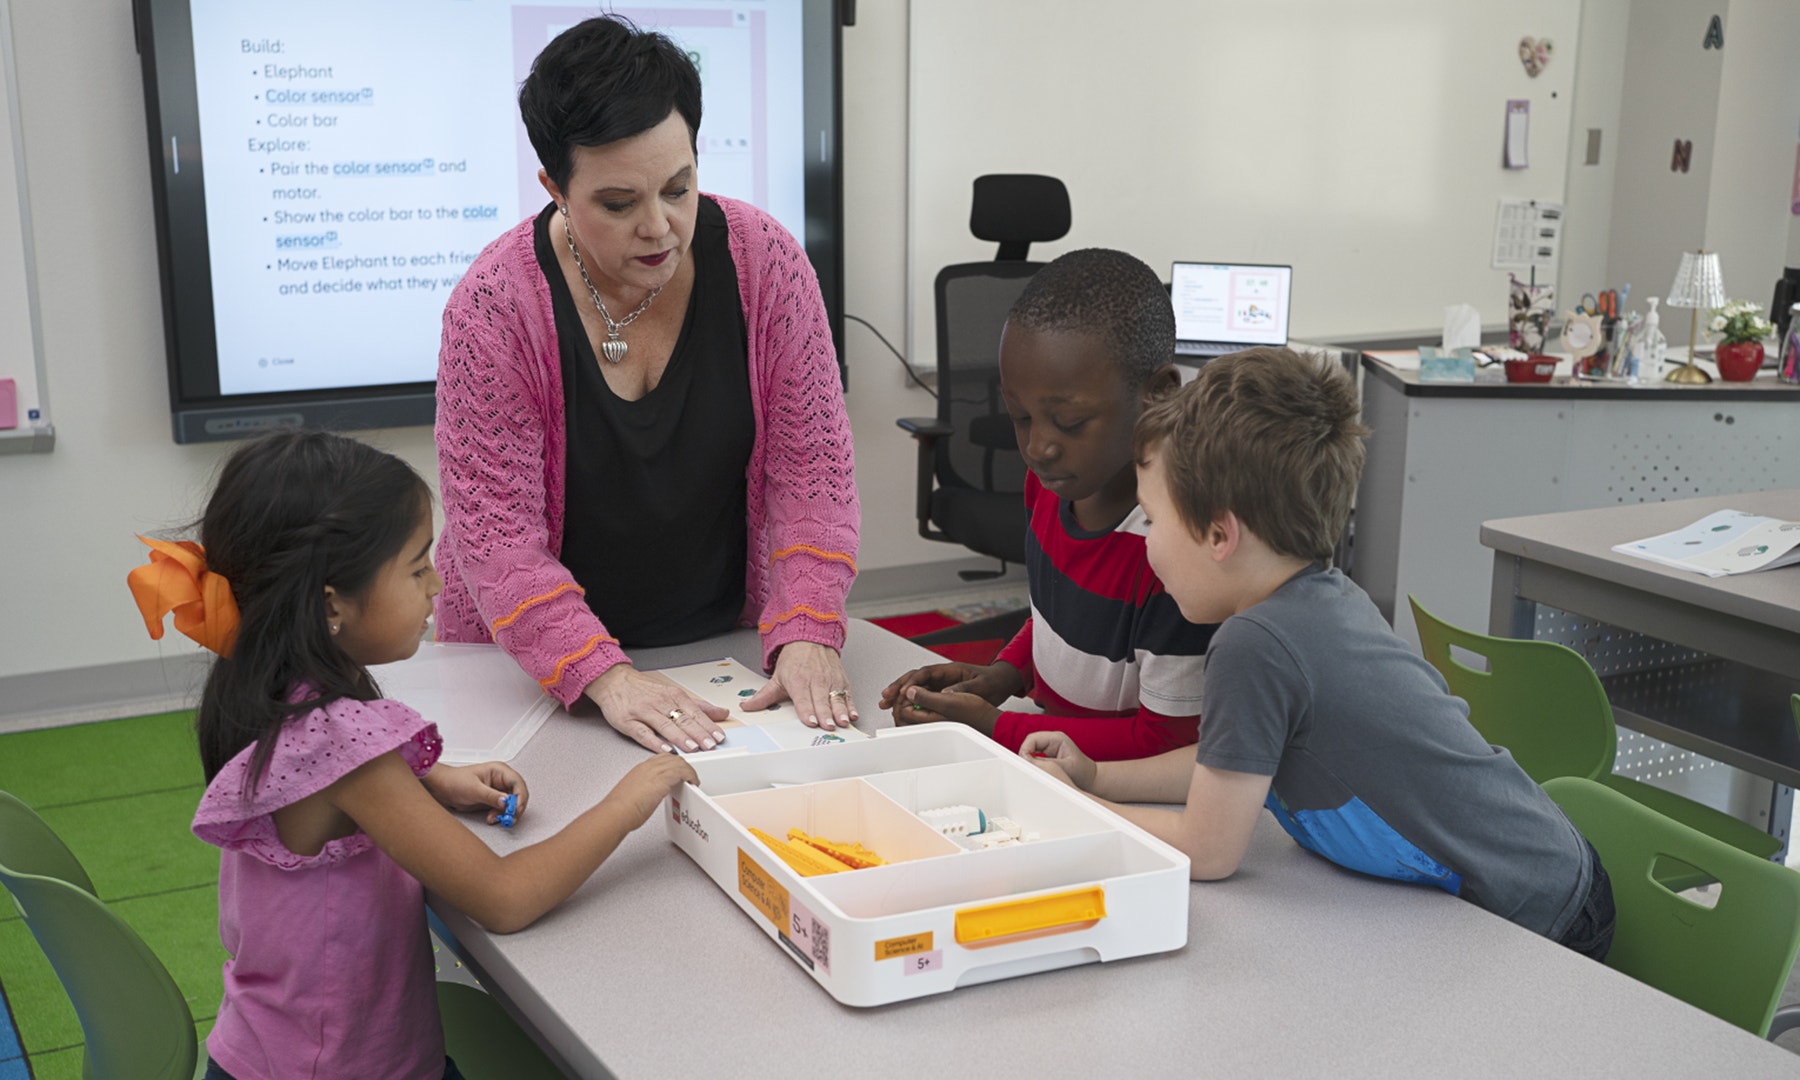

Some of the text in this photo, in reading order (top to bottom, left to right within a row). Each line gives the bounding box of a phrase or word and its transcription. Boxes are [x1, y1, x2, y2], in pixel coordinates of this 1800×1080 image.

[1703, 14, 1724, 49] A
[240, 39, 285, 54] Build:
[264, 64, 333, 81] Elephant
[265, 88, 360, 103] Color sensor
[267, 113, 338, 127] Color bar
[248, 137, 311, 154] Explore:
[1671, 138, 1692, 173] N
[271, 160, 467, 176] Pair the color sensor and
[273, 188, 321, 200] motor.
[274, 205, 498, 224] Show the color bar to the color
[278, 257, 318, 271] Move
[322, 253, 388, 271] Elephant
[393, 255, 406, 268] to
[410, 251, 446, 266] each
[279, 280, 308, 295] and
[312, 279, 362, 294] decide
[367, 277, 402, 291] what
[407, 276, 438, 291] they
[681, 810, 710, 843] education
[793, 912, 809, 939] 5+
[917, 957, 930, 970] 5+
